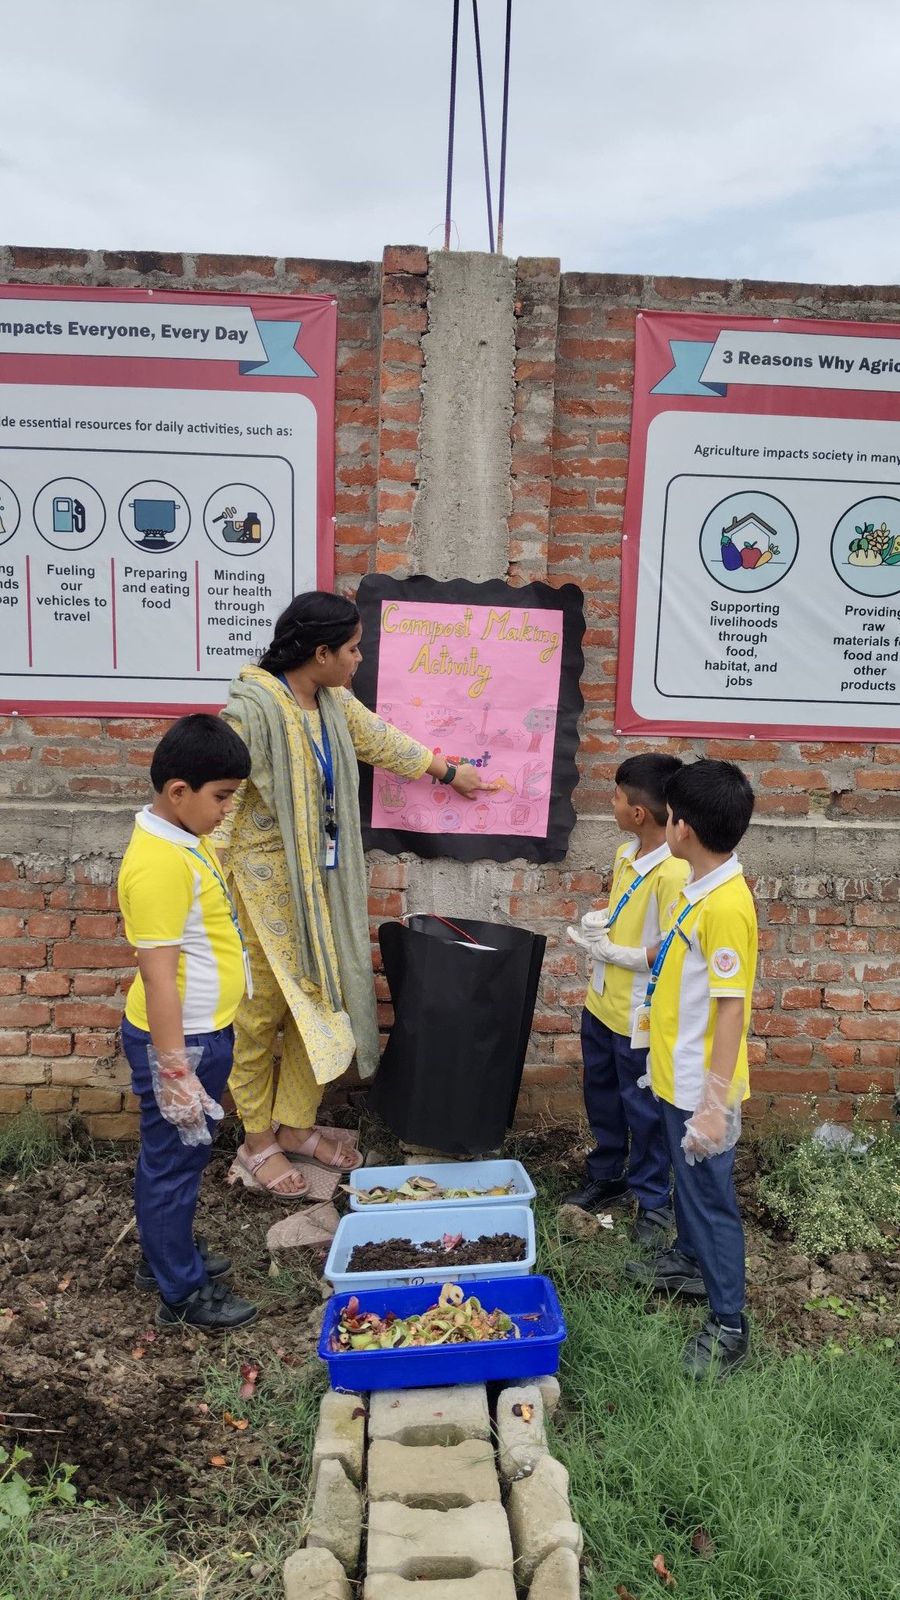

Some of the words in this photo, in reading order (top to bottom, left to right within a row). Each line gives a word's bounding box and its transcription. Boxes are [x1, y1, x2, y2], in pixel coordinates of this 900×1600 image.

[68, 321, 156, 341] Everyone,
[161, 323, 210, 343] Every
[215, 325, 249, 345] Day
[722, 350, 734, 364] 3
[738, 350, 814, 368] Reasons
[818, 354, 855, 374] Why
[18, 417, 72, 429] essential
[74, 420, 132, 431] resources
[134, 419, 153, 432] for
[155, 420, 184, 435] daily
[186, 422, 243, 437] activities,
[246, 424, 273, 436] such
[276, 427, 293, 437] as:
[693, 444, 760, 458] Agriculture
[762, 446, 810, 461] impacts
[811, 449, 854, 464] society
[856, 450, 868, 462] in
[870, 453, 900, 467] many
[46, 563, 96, 580] Fueling
[124, 566, 188, 582] Preparing
[214, 569, 265, 585] Minding
[60, 582, 83, 592] our
[122, 582, 147, 593] and
[150, 583, 190, 598] eating
[207, 586, 230, 596] our
[232, 584, 272, 597] health
[36, 594, 91, 607] vehicles
[94, 596, 108, 608] to
[141, 597, 171, 609] food
[214, 599, 265, 615] through
[710, 600, 780, 616] Supporting
[53, 610, 91, 622] travel
[207, 615, 273, 627] medicines
[710, 615, 778, 629] livelihoods
[382, 603, 472, 644] Compost
[480, 608, 559, 663] Making
[862, 623, 886, 632] raw
[228, 630, 252, 642] and
[718, 630, 768, 646] through
[833, 635, 891, 647] materials
[206, 644, 267, 657] treatment
[725, 645, 758, 659] food,
[843, 649, 873, 661] food
[875, 651, 899, 662] and
[408, 643, 492, 698] Activity
[704, 659, 750, 674] habitat,
[754, 662, 778, 673] and
[853, 664, 888, 676] other
[725, 675, 753, 689] jobs
[840, 679, 896, 692] products
